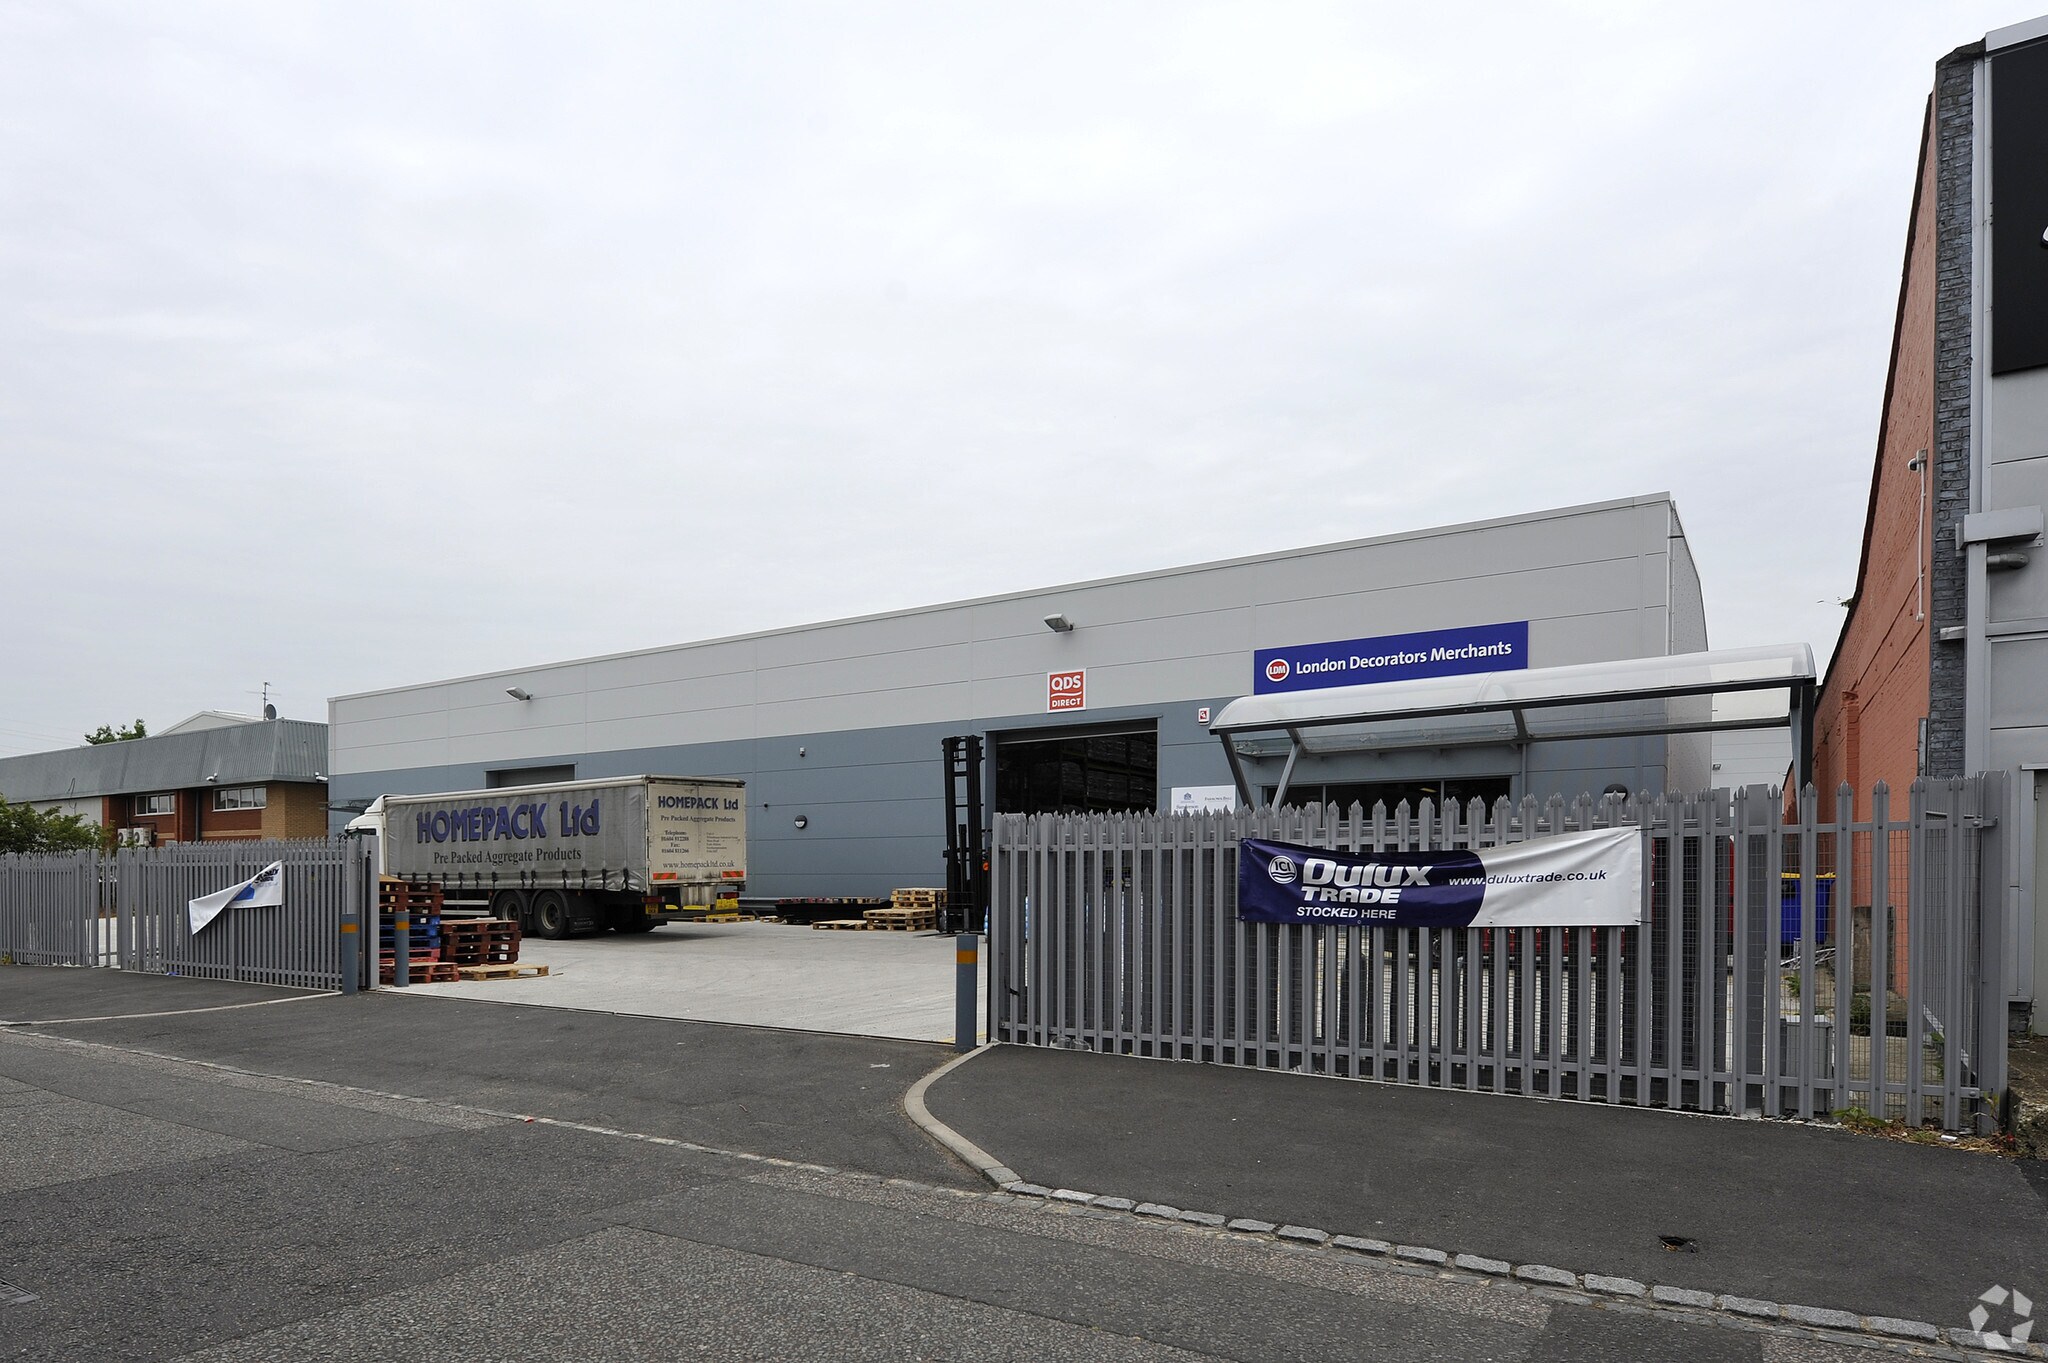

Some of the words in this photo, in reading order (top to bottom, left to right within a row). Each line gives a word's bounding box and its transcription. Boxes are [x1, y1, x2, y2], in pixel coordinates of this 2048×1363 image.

[1296, 658, 1346, 675] London
[1349, 651, 1427, 670] Decorators
[1430, 641, 1512, 661] Merchants
[1269, 665, 1286, 675] LDM
[1051, 675, 1082, 691] QDS
[1052, 698, 1082, 707] DIRECT
[658, 796, 719, 810] HOMEPACK
[723, 798, 739, 810] Ltd
[416, 803, 547, 844] HOMEPACK
[559, 799, 600, 837] Ltd
[434, 852, 449, 864] Pre
[451, 850, 483, 864] Packed
[484, 850, 533, 866] Aggregate
[536, 847, 582, 861] Products
[662, 860, 735, 869] www.homepackltd.co.uk
[1274, 861, 1291, 872] ICI
[1302, 857, 1433, 887] Dulux
[1448, 869, 1608, 886] www.duluxtrade.co.uk
[1300, 886, 1402, 904] TRADE
[1296, 906, 1358, 918] STOCKED
[1361, 909, 1397, 919] HERE
